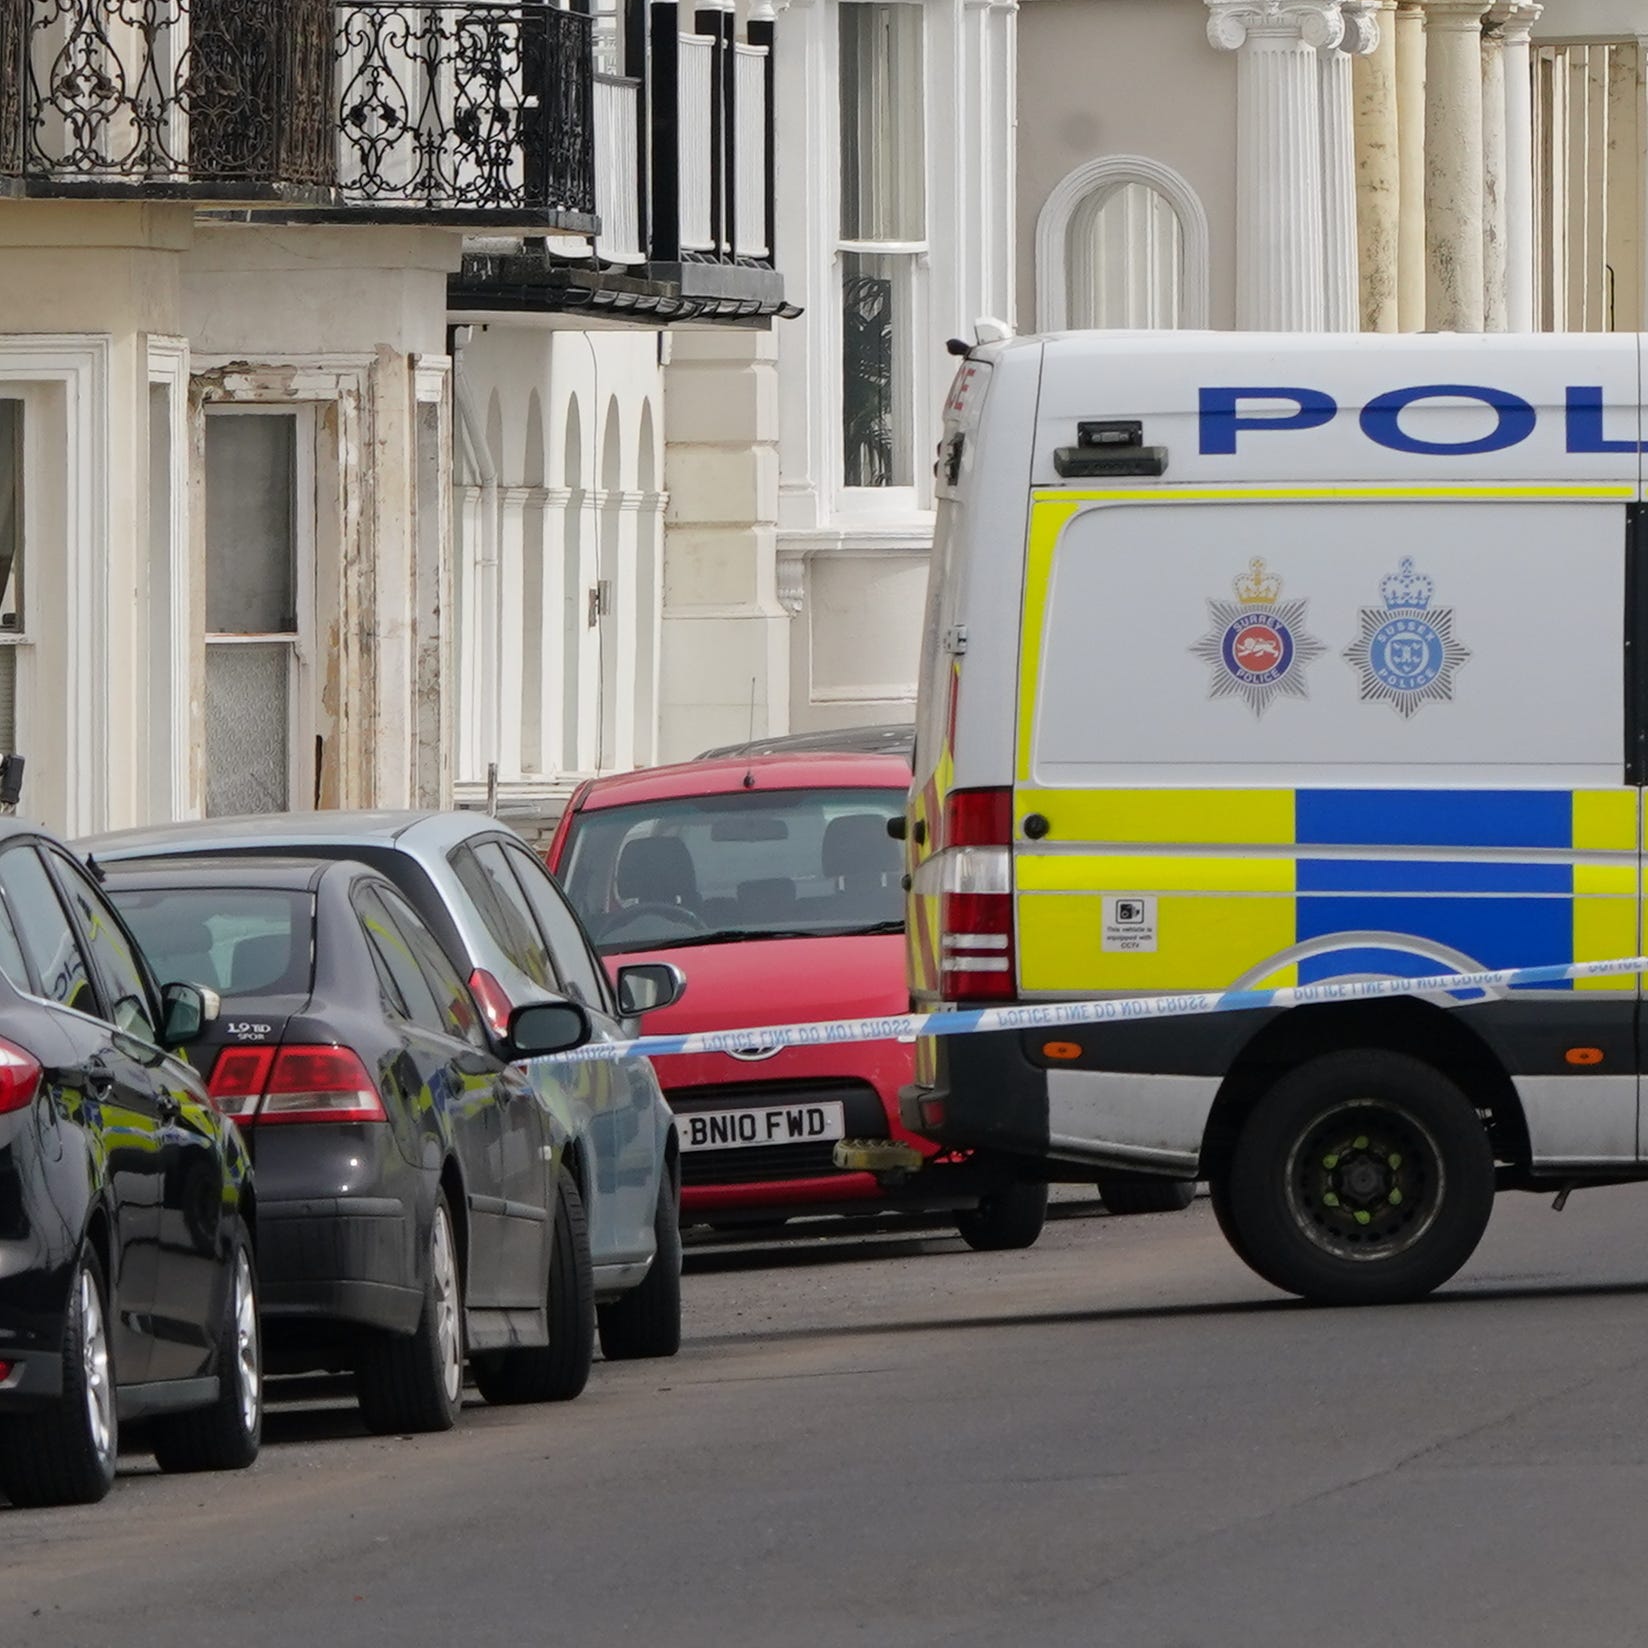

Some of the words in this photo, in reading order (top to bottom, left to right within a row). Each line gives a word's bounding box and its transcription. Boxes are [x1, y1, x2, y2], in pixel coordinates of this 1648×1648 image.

[1233, 614, 1283, 633] SURREY
[1378, 621, 1435, 643] SUSSEX
[1236, 669, 1280, 685] POLICE
[1378, 668, 1435, 690] POLICE
[689, 1114, 756, 1145] BN10
[766, 1108, 825, 1139] FWD
